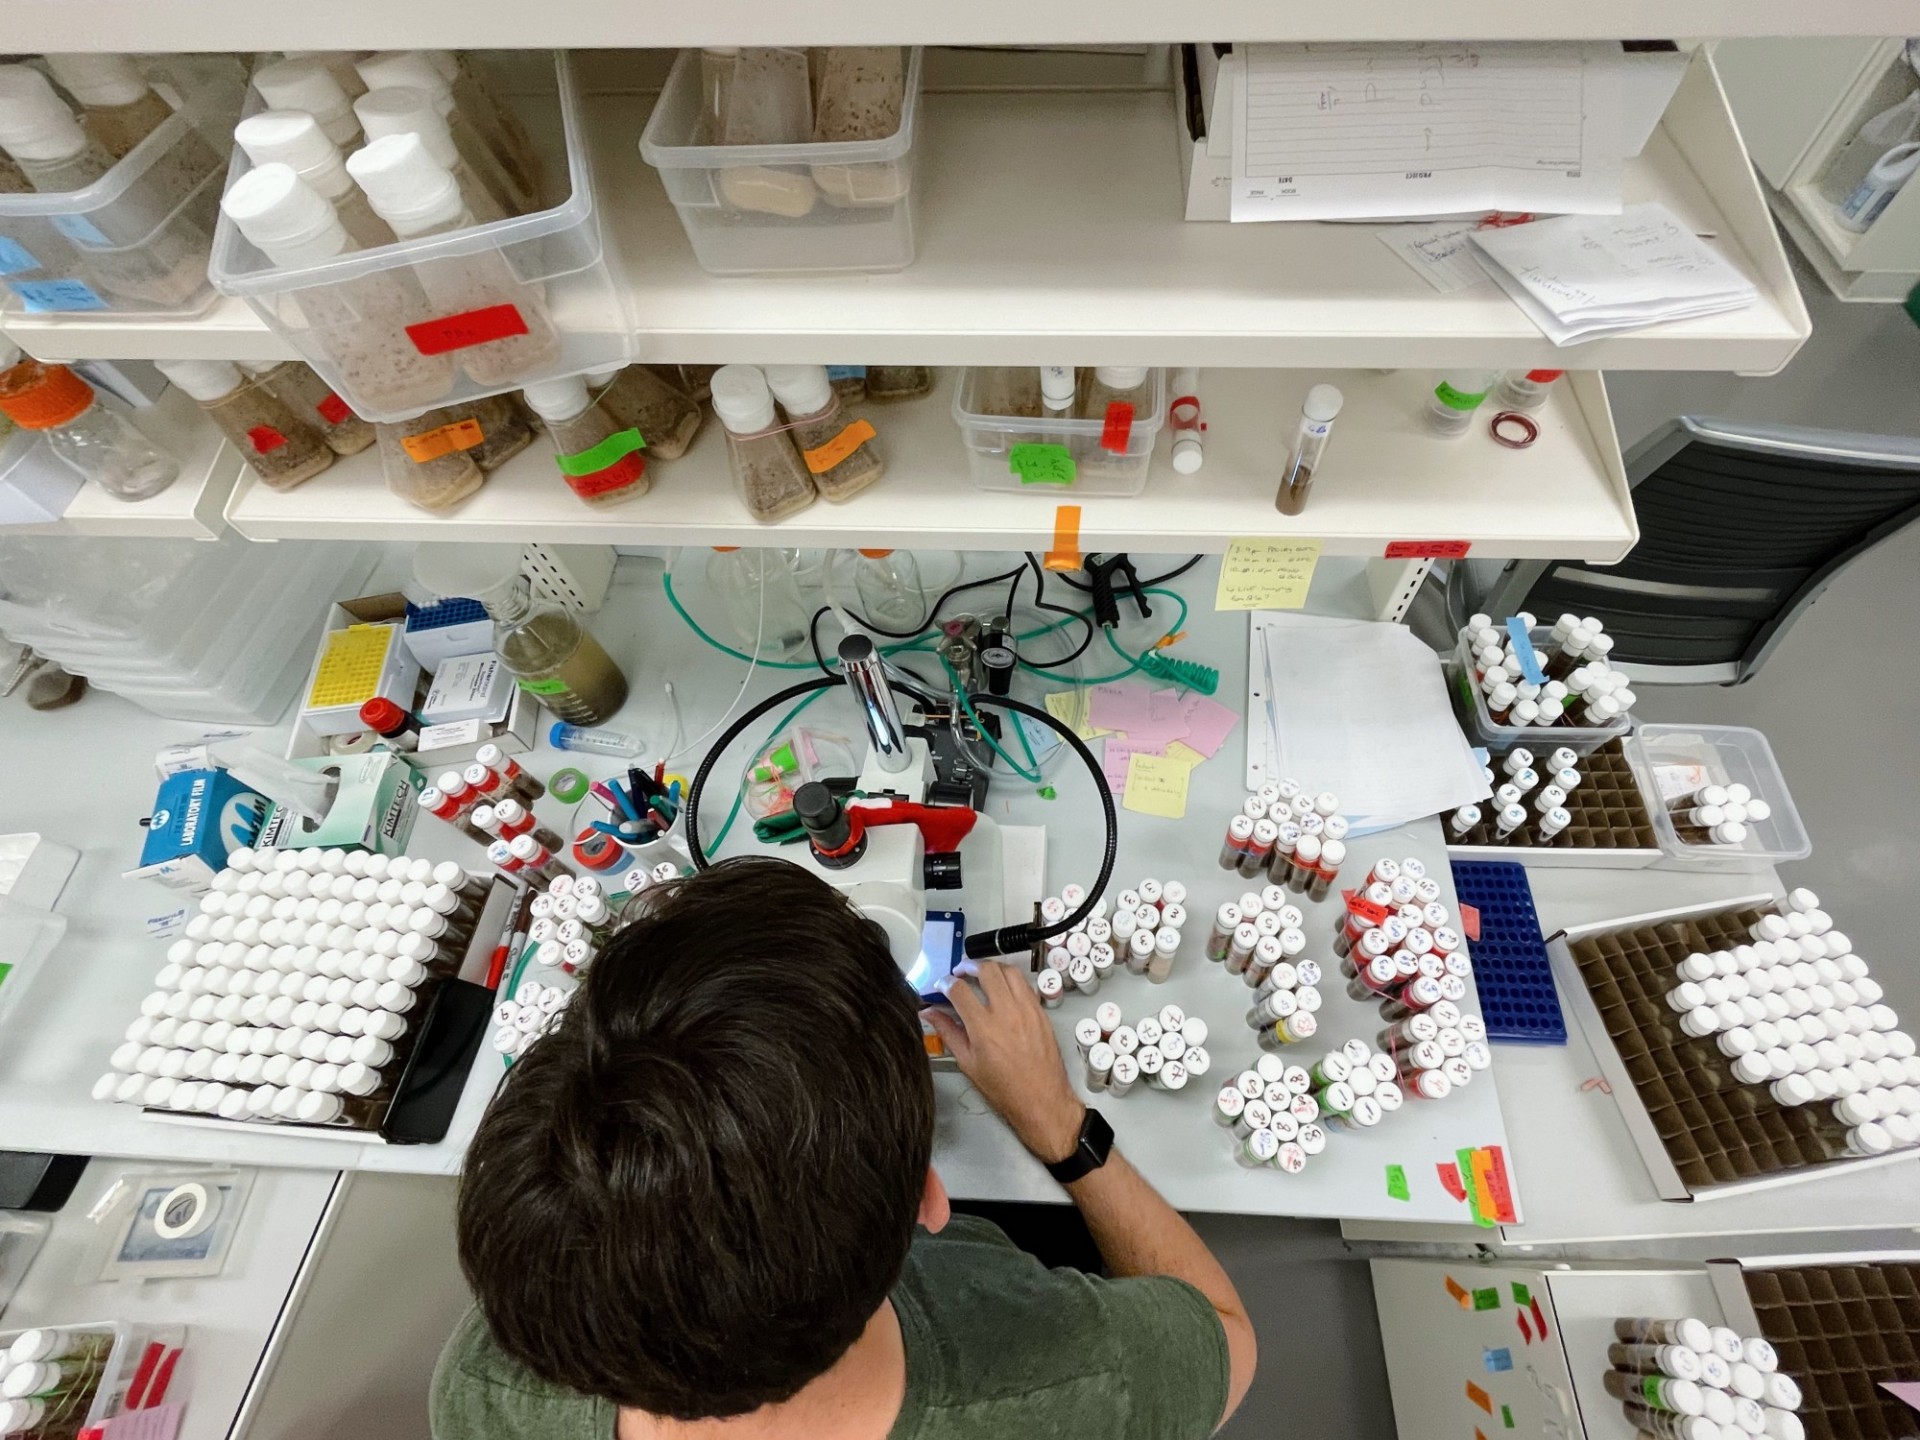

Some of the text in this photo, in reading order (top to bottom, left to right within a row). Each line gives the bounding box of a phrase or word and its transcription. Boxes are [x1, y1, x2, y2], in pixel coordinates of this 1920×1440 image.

[1405, 172, 1432, 180] PROJECT
[180, 799, 202, 847] LABORATORY
[191, 778, 206, 796] FILM
[262, 806, 284, 848] KIMTEC
[383, 779, 409, 837] KIMTECH
